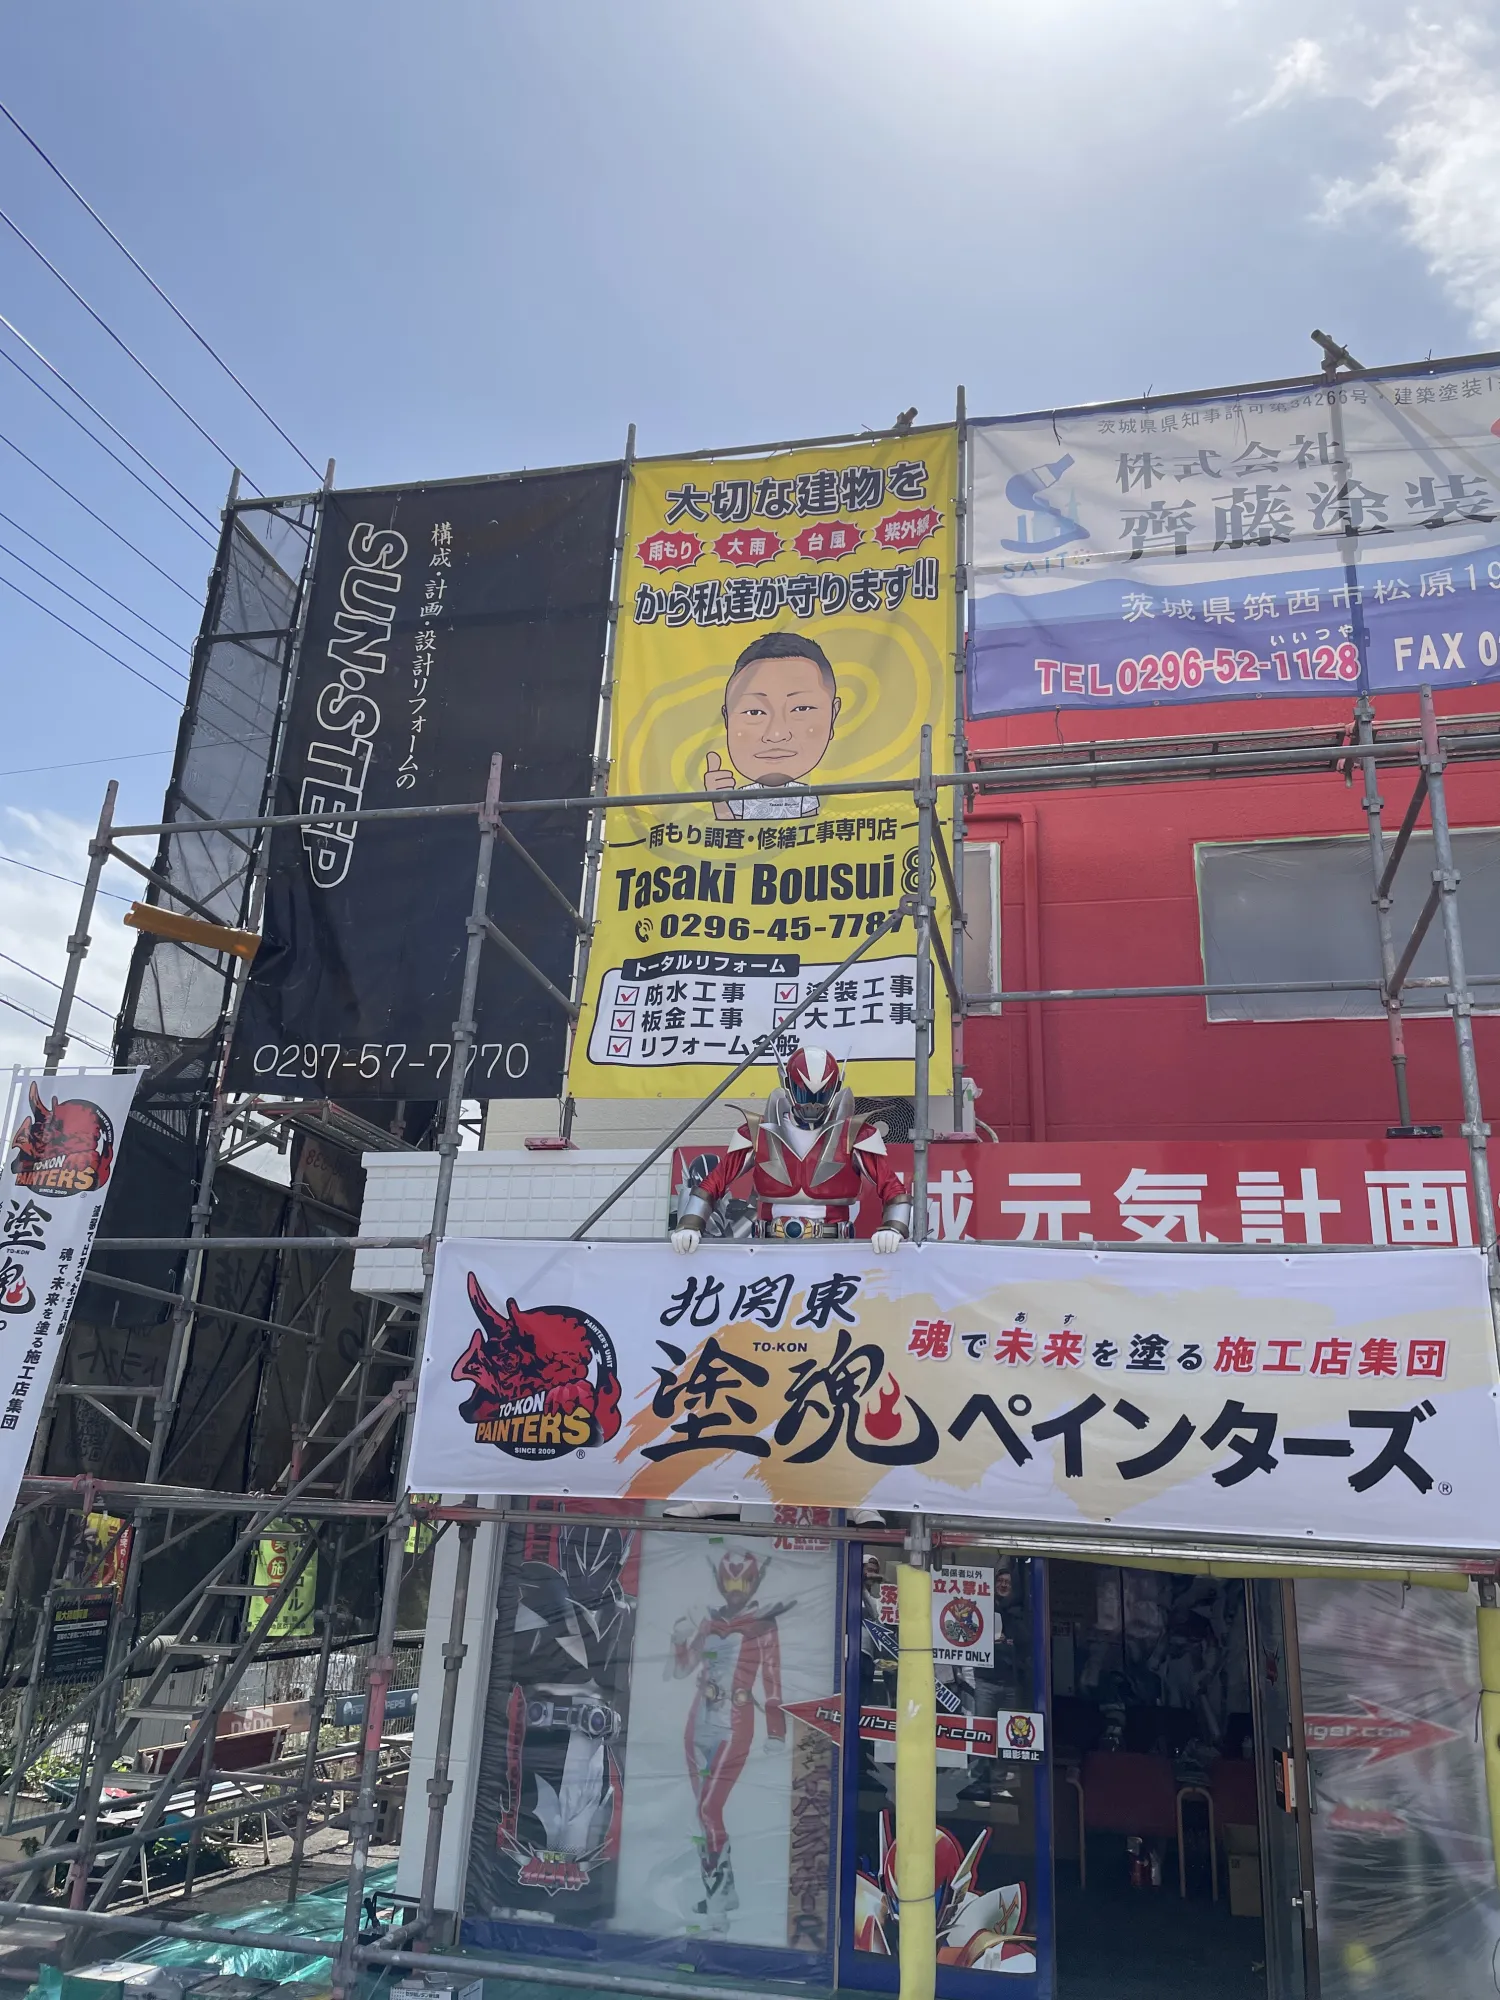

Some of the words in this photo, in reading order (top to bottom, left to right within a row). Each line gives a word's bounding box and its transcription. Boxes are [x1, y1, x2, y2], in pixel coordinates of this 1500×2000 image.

[1097, 375, 1500, 435] 茨城県県知事許可第34266号・建築塗装1
[1115, 431, 1342, 493] 株式会社
[665, 460, 928, 525] 大切な建物を
[807, 531, 846, 552] 台風
[884, 515, 930, 542] 紫外線
[648, 540, 692, 562] 雨もり
[727, 536, 766, 556] 大雨
[633, 557, 939, 627] から私達が守ります!!
[1270, 624, 1355, 647] いいつや
[396, 521, 454, 789] 構成・計画・設計リフォームの
[1394, 631, 1467, 671] FAX
[1478, 631, 1500, 667] 0
[1034, 659, 1113, 697] TEL
[1116, 641, 1362, 694] 0296-52-1128
[649, 817, 897, 850] 雨もり調査・修繕工事専門店
[616, 860, 736, 911] Tasaki
[751, 854, 894, 906] Bousui
[635, 955, 786, 978] トータルリフォーム
[644, 981, 745, 1007] 防水工事
[806, 975, 914, 1004] 塗装工事
[641, 1007, 744, 1032] 板金工事
[803, 1002, 915, 1030] 大工工事
[640, 1034, 800, 1058] リフォーム全般
[850, 1167, 1474, 1245] 城元気計画
[659, 1272, 861, 1328] 北関東
[0, 1247, 75, 1430] 魂で未来を塗る施工店集団
[752, 1341, 808, 1353] TO-KON
[907, 1318, 1447, 1378] 魂で未来を塗る施工店集団
[604, 1349, 613, 1368] UNIT
[499, 1393, 545, 1419] TO-KON
[476, 1404, 593, 1444] PAINTERS
[514, 1446, 536, 1455] SINCE
[538, 1446, 556, 1455] 2009
[933, 1578, 991, 1597] 立入禁止
[941, 1568, 983, 1580] 関係者以外
[932, 1647, 964, 1661] STAFF
[965, 1650, 991, 1664] ONLY
